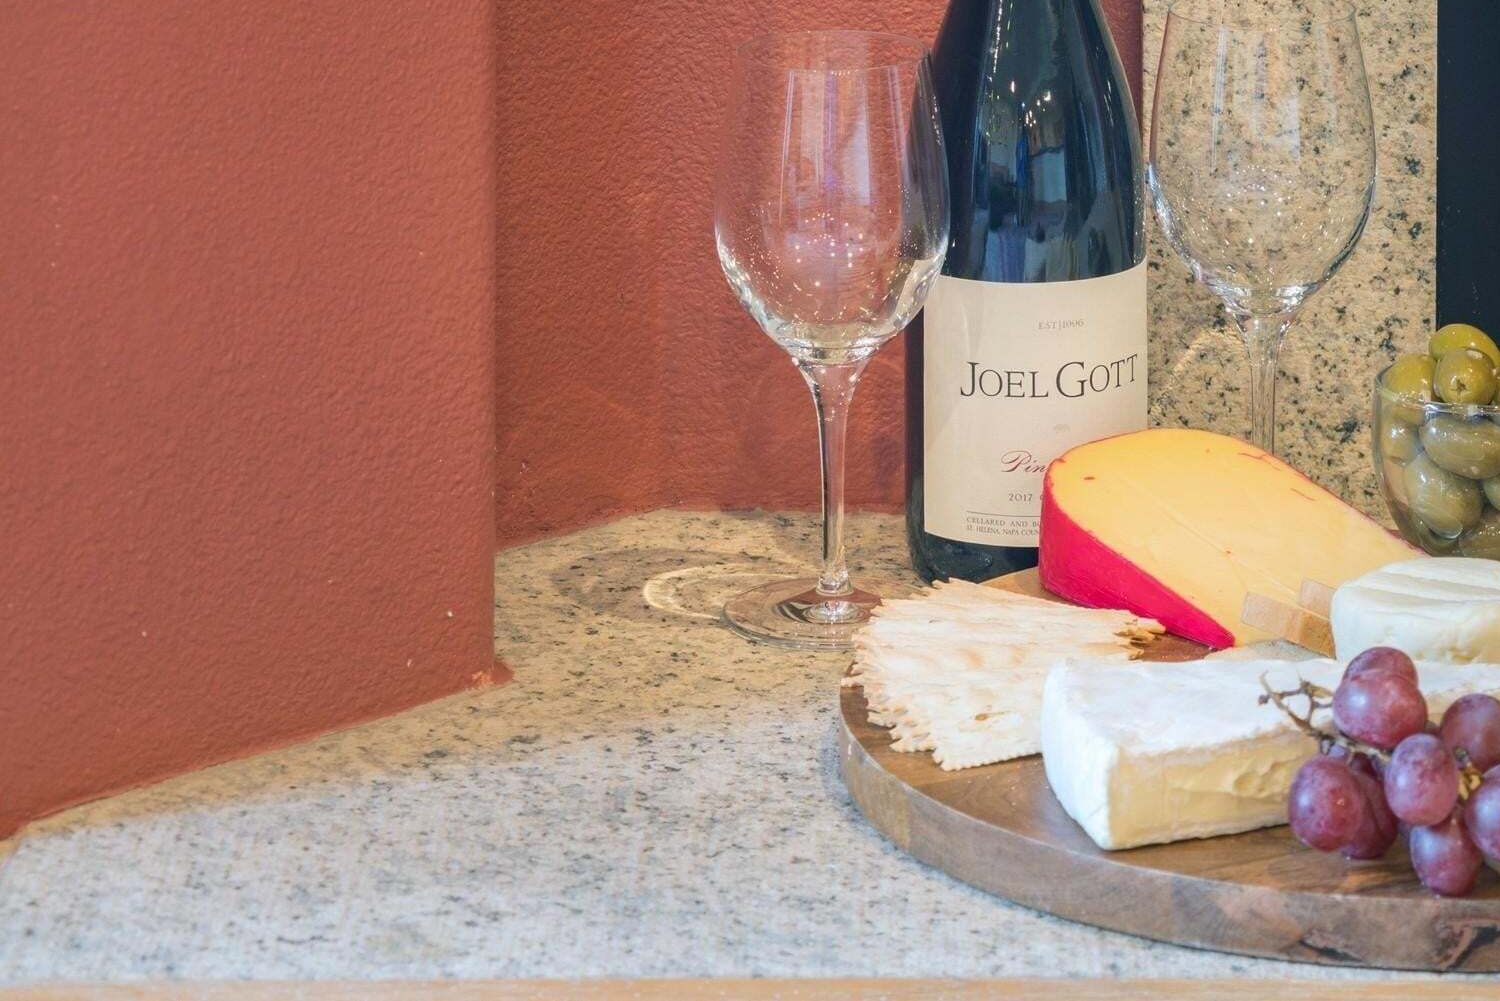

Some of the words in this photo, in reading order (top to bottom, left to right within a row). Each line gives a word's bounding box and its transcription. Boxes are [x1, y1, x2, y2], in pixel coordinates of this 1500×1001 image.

[960, 361, 1049, 398] JOEL
[1056, 353, 1138, 398] GOTT
[1008, 493, 1033, 502] 2017
[1010, 520, 1029, 528] AND
